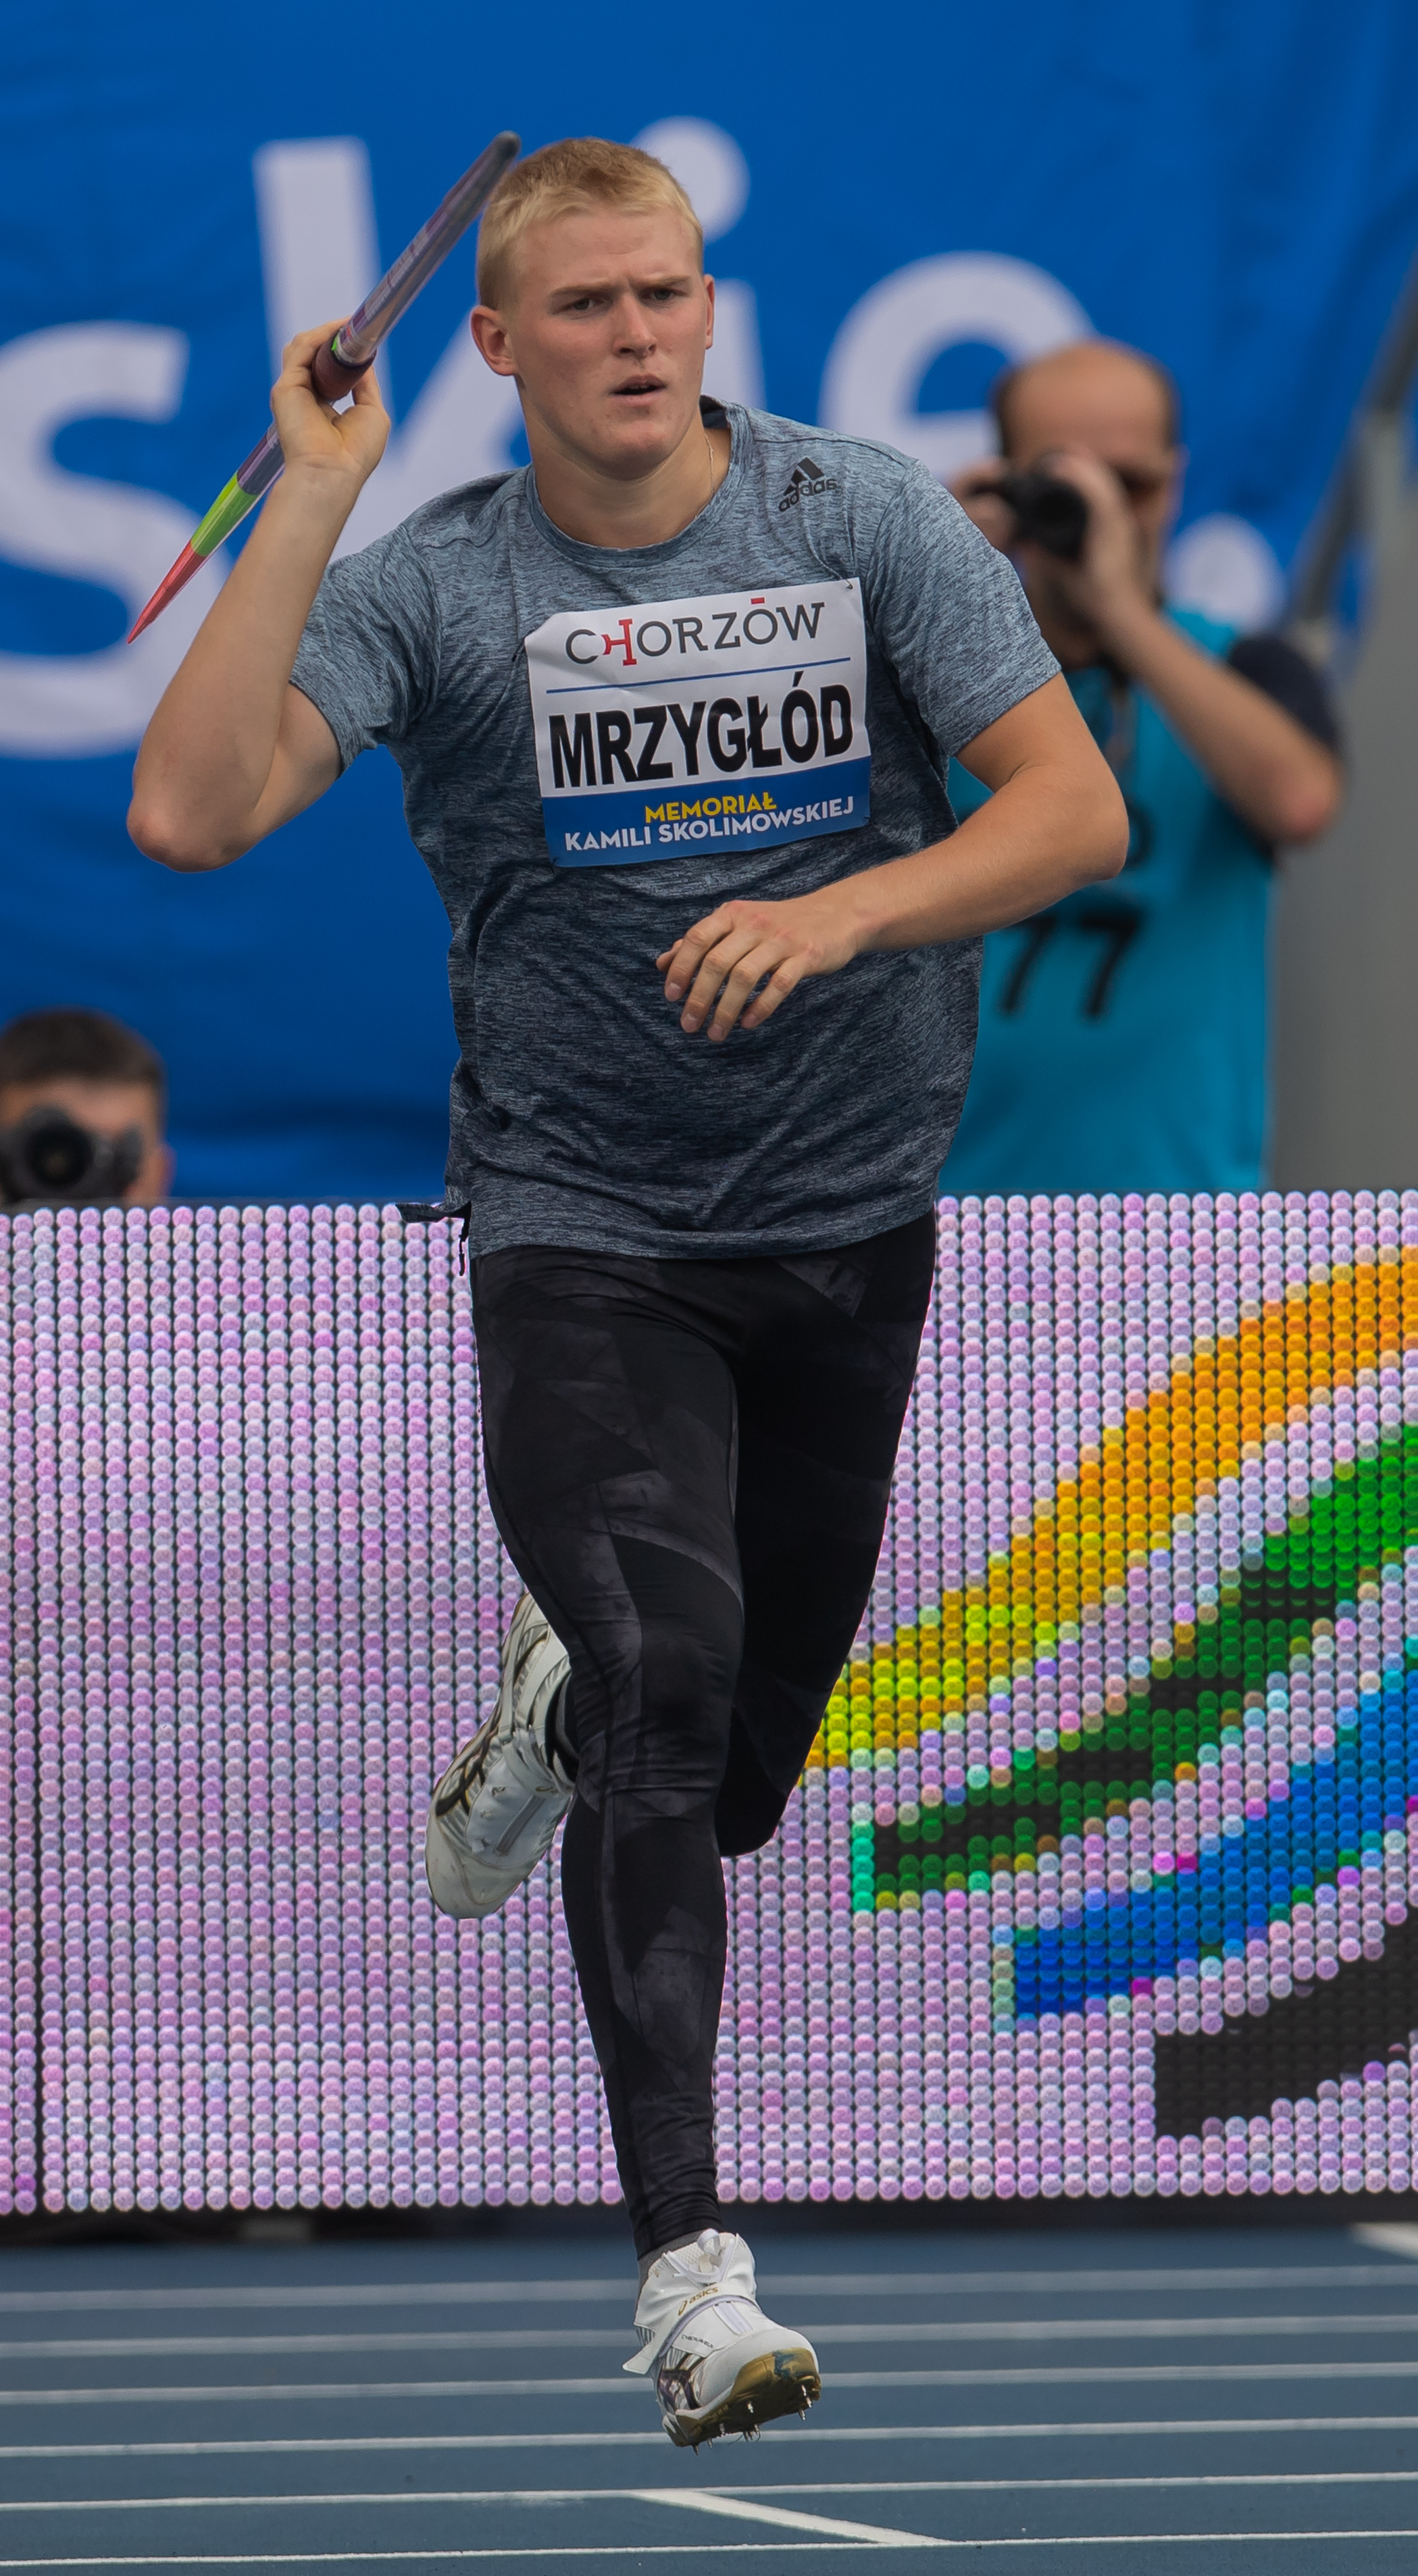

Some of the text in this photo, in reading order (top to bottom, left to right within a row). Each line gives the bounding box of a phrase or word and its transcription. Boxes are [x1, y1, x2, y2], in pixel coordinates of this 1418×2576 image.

[778, 478, 838, 512] adidas
[549, 670, 853, 788] MRZYGŁÓD
[565, 796, 854, 851] KAMILI SKOLIMOWSKIEJ
[645, 792, 778, 823] MEMORIAŁ
